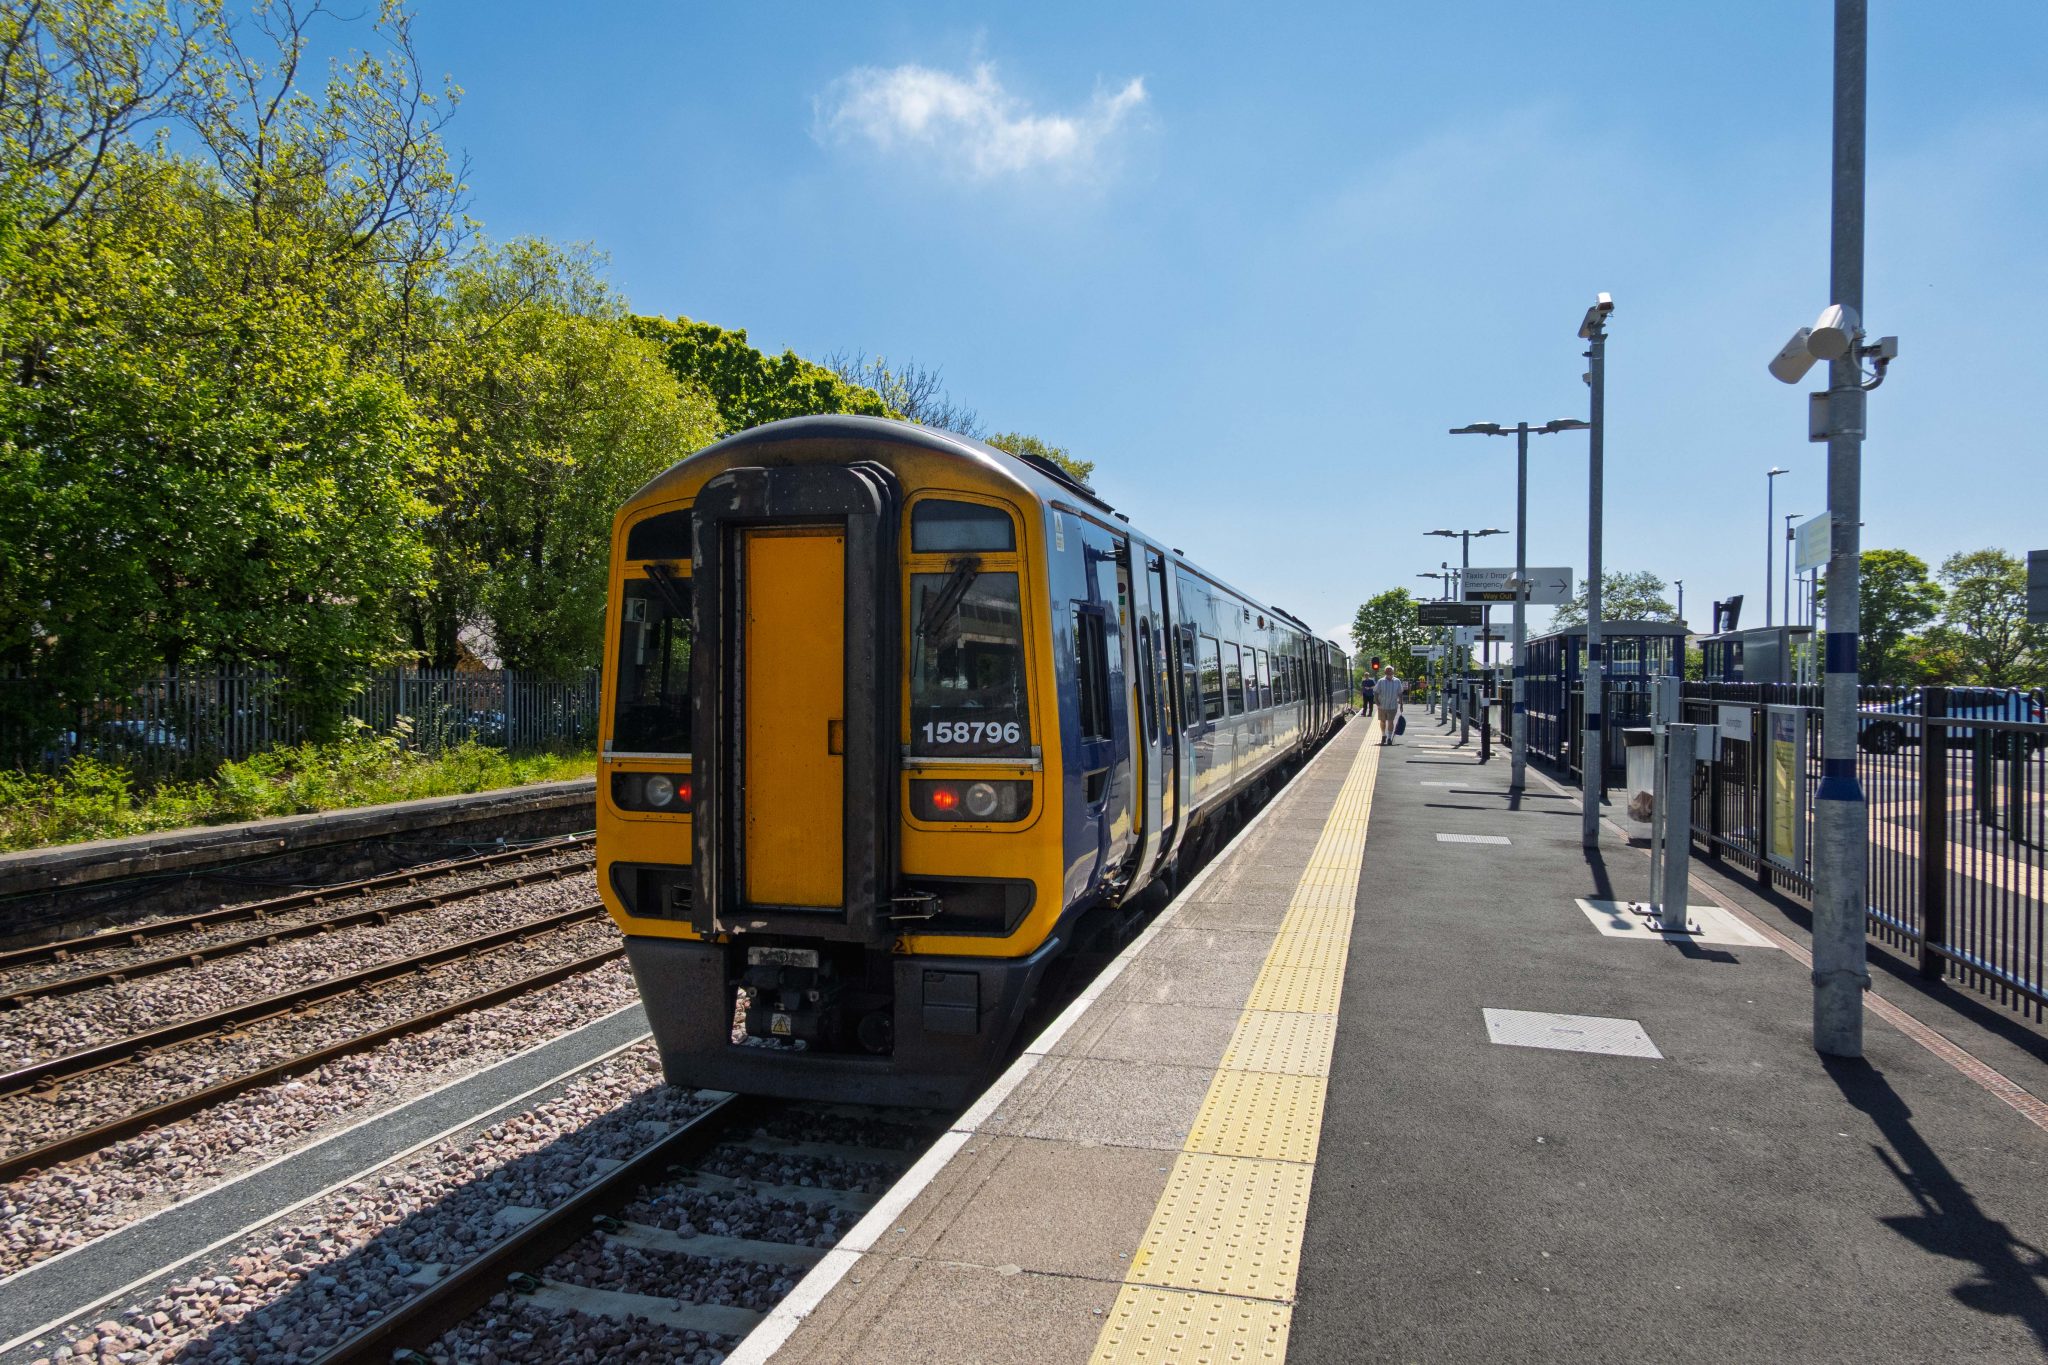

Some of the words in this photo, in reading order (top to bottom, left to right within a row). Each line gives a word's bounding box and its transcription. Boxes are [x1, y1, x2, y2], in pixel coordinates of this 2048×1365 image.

[1490, 572, 1508, 580] Drop
[1483, 593, 1498, 601] Way
[1463, 631, 1467, 640] 1
[922, 721, 1020, 744] 158796
